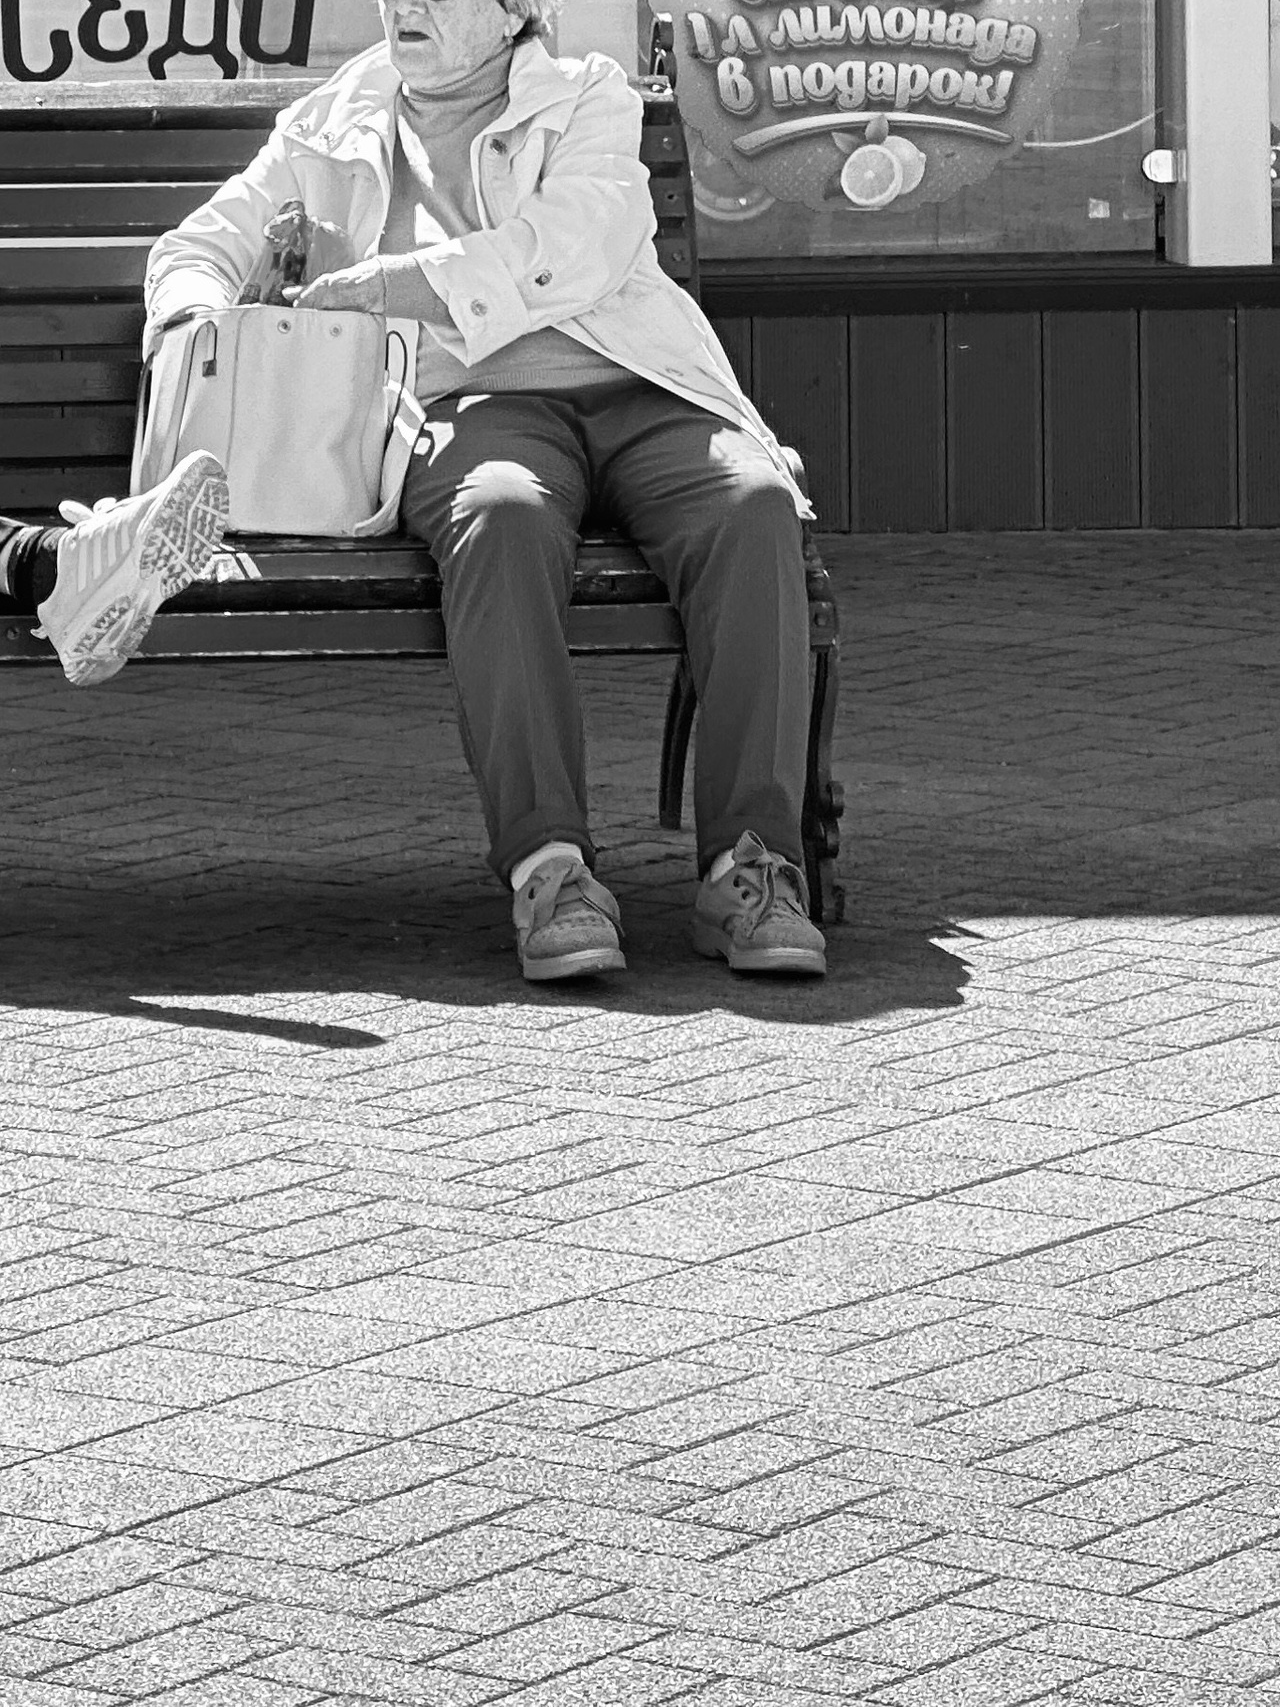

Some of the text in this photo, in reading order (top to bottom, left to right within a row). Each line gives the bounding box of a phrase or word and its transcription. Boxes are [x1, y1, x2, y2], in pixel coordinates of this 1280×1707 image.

[687, 4, 1038, 66] 1 л лимонада
[717, 56, 1015, 115] в подарок!
